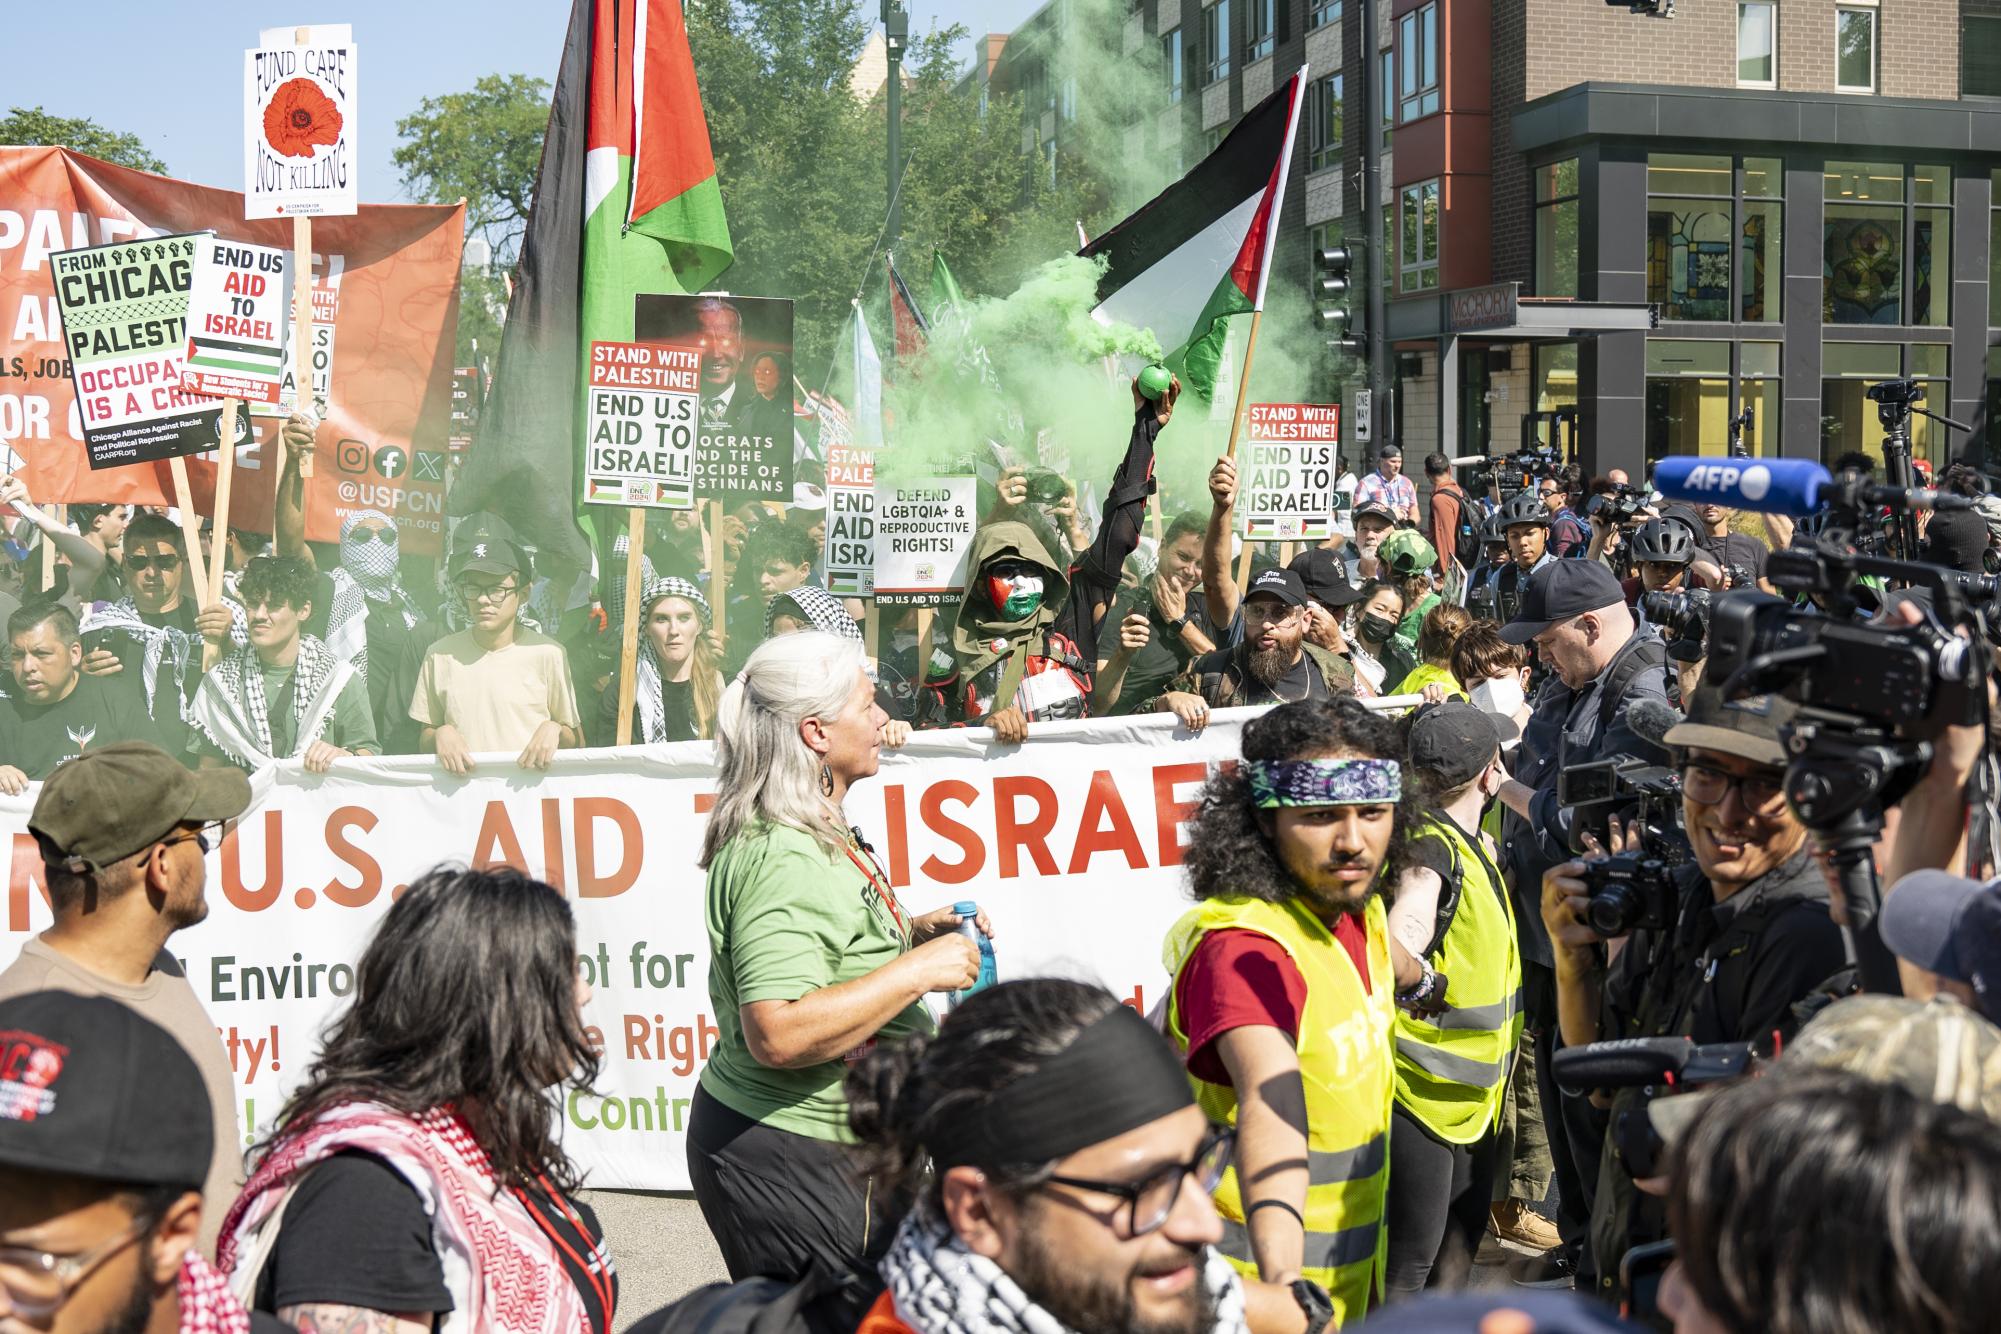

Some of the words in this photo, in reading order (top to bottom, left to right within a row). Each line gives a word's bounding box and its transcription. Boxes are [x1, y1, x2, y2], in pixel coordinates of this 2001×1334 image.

[255, 51, 297, 107] FUND
[305, 49, 346, 101] CARE
[256, 140, 285, 193] NOT
[290, 138, 347, 190] KILLING
[59, 252, 107, 274] FROM
[212, 245, 254, 269] END
[258, 253, 283, 274] US
[60, 259, 193, 308] CHICAG
[223, 271, 266, 298] AID
[231, 296, 255, 318] TO
[311, 291, 335, 305] ITH
[1452, 286, 1511, 318] McCRORY
[70, 316, 187, 358] PALESTI
[204, 313, 275, 342] ISRAEL
[0, 357, 28, 381] LS,
[594, 346, 651, 365] STAND
[657, 350, 699, 369] WITH
[79, 357, 184, 395] OCCUPA
[219, 376, 252, 389] Students
[593, 366, 698, 389] PALESTINE!
[87, 396, 113, 422] IS
[125, 392, 142, 416] A
[596, 394, 644, 417] END
[654, 397, 691, 421] U.S
[1357, 394, 1368, 407] ONE
[0, 394, 50, 441] OR
[1252, 407, 1297, 421] STAND
[1301, 408, 1336, 421] WITH
[1357, 406, 1369, 421] WAY
[91, 432, 121, 443] Chicago
[122, 426, 151, 438] Alliance
[151, 422, 180, 434] Against
[180, 418, 203, 429] Racist
[593, 419, 642, 446] AID
[655, 423, 691, 450] TO
[699, 435, 773, 448] OCRATS
[1251, 424, 1335, 439] PALESTINE!
[93, 444, 108, 453] and
[108, 439, 138, 450] Political
[138, 432, 180, 446] Repression
[94, 448, 137, 462] CAARPR.org
[593, 448, 690, 478] ISRAEL!
[696, 449, 720, 461] ND
[729, 449, 762, 462] THE
[1253, 447, 1292, 465] END
[1300, 447, 1330, 465] U.S
[694, 463, 748, 476] OCIDE
[757, 465, 780, 478] OF
[831, 466, 873, 484] PALE
[1251, 468, 1291, 489] AID
[1300, 468, 1330, 489] TO
[1683, 465, 1740, 492] AFP
[697, 477, 784, 493] STINIANS
[896, 488, 951, 502] DEFEND
[338, 480, 442, 514] @USPCN
[833, 493, 874, 513] END
[1251, 493, 1328, 512] ISRAEL!
[882, 505, 949, 519] LGBTQIA+
[954, 505, 965, 518] &
[831, 516, 874, 540] AID
[879, 521, 970, 534] REPRODUCTIVE
[892, 538, 954, 553] RIGHTS!
[876, 596, 893, 604] END
[895, 595, 909, 604] U.S
[911, 595, 926, 604] AID
[928, 595, 940, 603] TO
[942, 595, 963, 603] ISRA
[471, 796, 643, 899] AID
[883, 760, 1242, 887] ISRAE
[211, 953, 358, 1003] Enviro
[578, 942, 610, 989] ot
[630, 941, 695, 989] for
[623, 1013, 720, 1077] Righ
[568, 1086, 690, 1132] Contr
